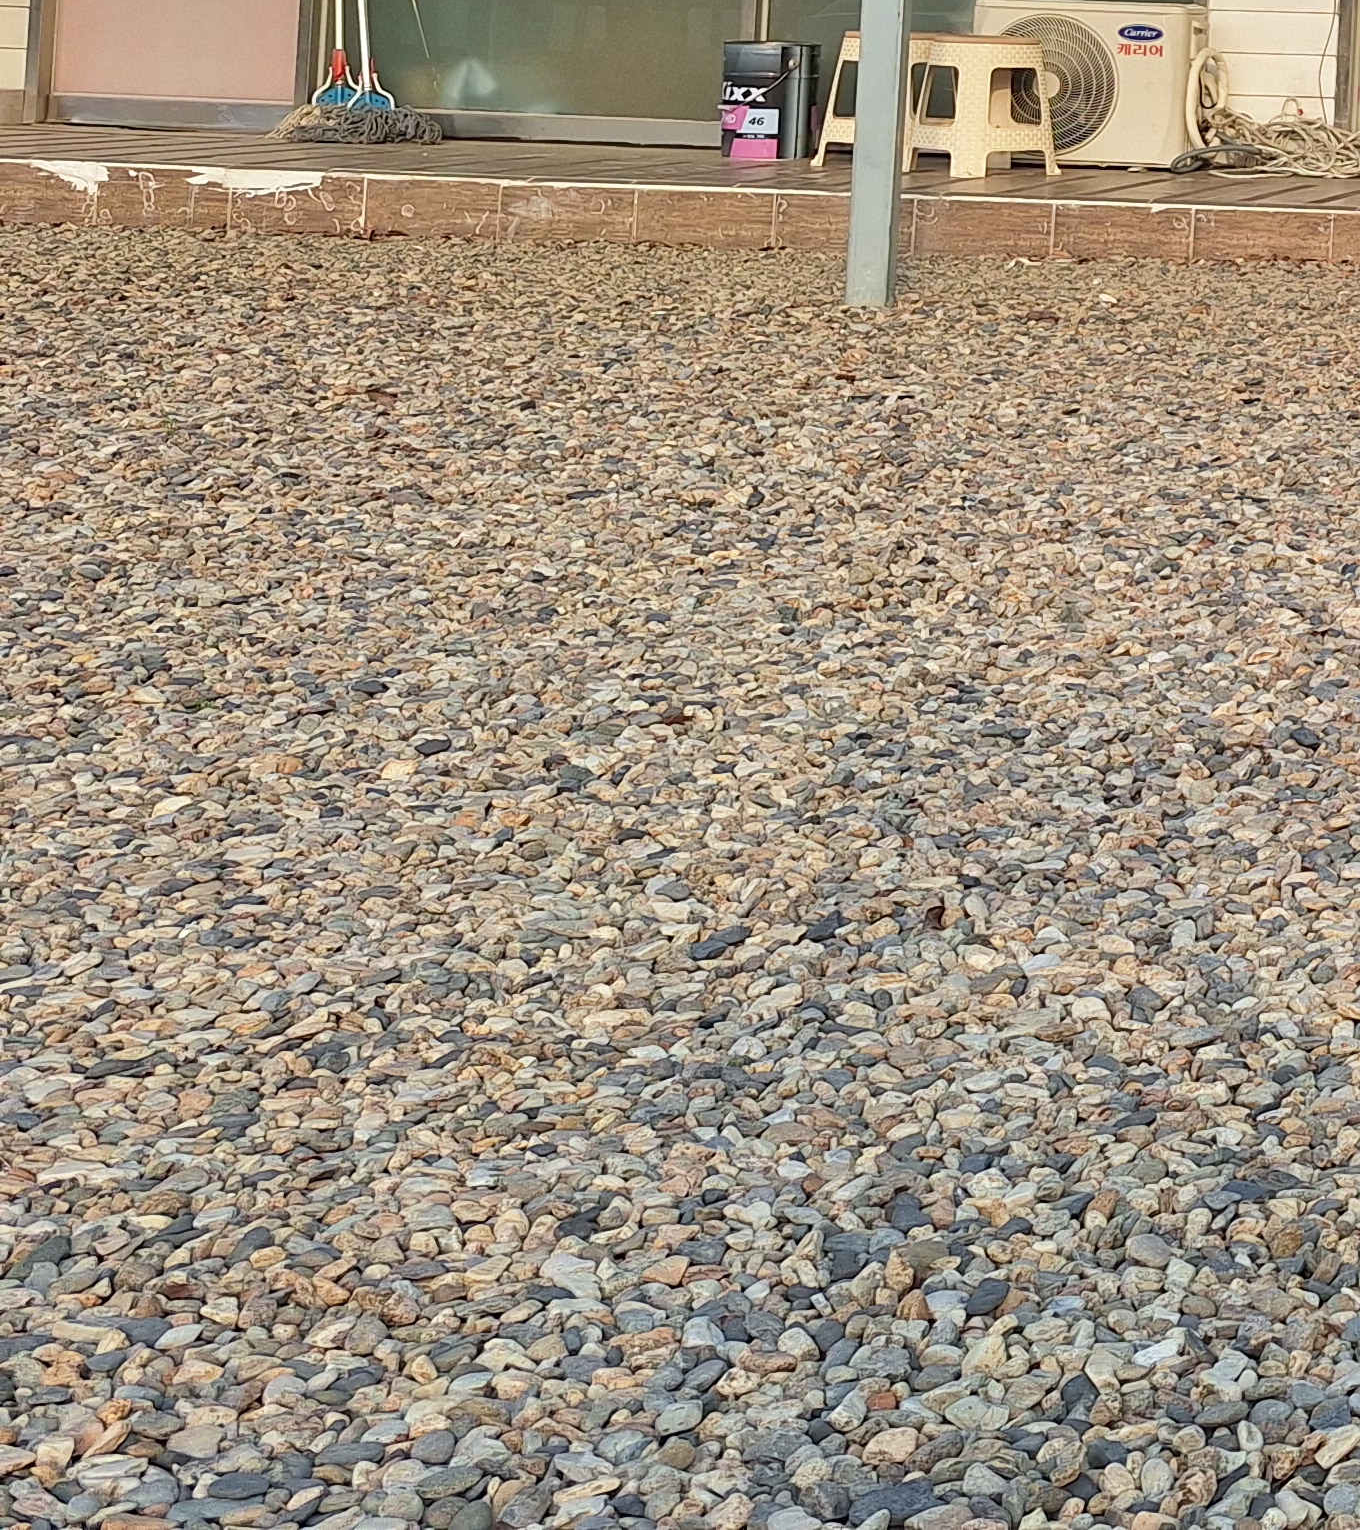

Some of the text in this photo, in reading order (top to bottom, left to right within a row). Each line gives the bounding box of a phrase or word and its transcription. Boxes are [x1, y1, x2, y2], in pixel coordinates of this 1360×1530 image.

[1123, 28, 1159, 37] Carrier
[1117, 43, 1163, 57] 캐리어
[748, 116, 765, 126] 46
